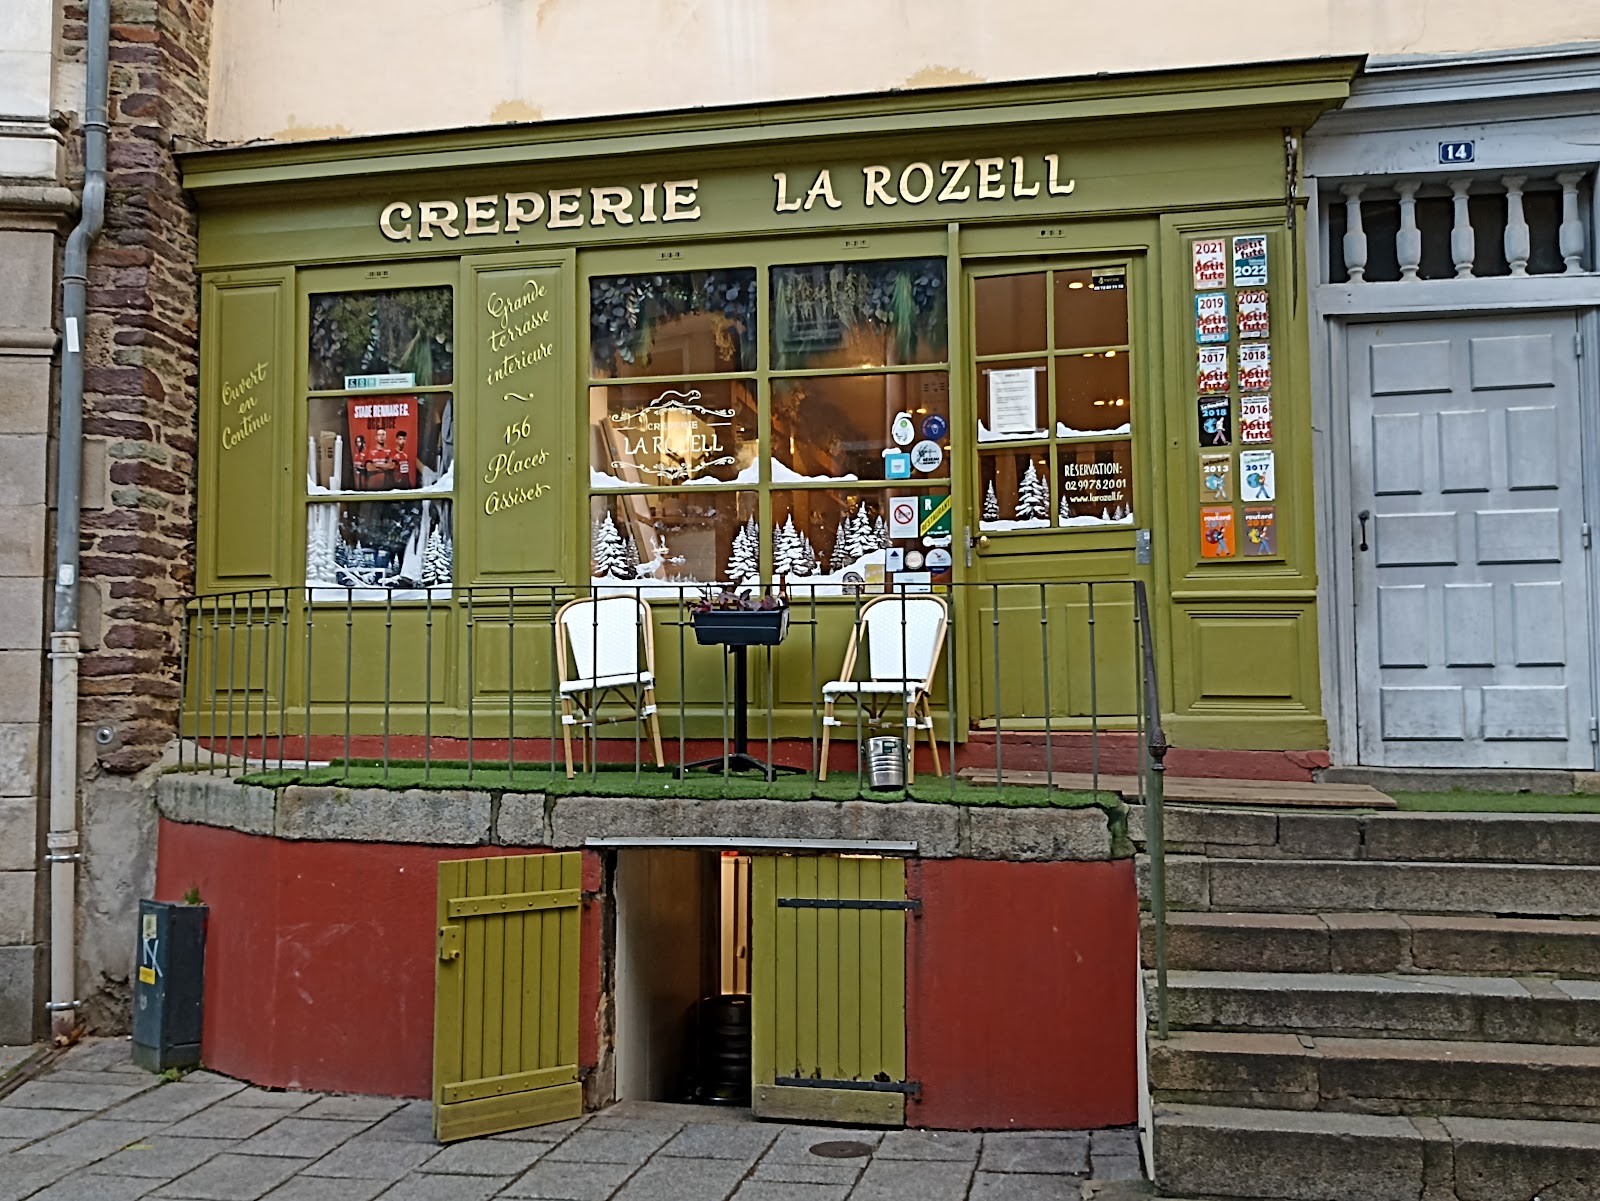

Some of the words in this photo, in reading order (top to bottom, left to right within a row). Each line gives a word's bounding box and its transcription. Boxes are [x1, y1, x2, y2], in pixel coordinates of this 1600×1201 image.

[1447, 144, 1467, 160] 14
[773, 169, 842, 214] LA
[862, 153, 1075, 207] ROZELL
[379, 179, 701, 242] CREPERIE
[1196, 243, 1222, 255] 2021
[1235, 240, 1263, 253] petit
[1195, 261, 1224, 274] petit
[1235, 266, 1265, 276] 2022
[487, 280, 548, 329] Grande
[1200, 298, 1224, 309] 2019
[1239, 294, 1266, 304] 2020
[1197, 314, 1227, 328] petit
[1238, 311, 1268, 324] petit
[487, 310, 550, 352] terrasse
[1201, 354, 1224, 363] 2017
[1242, 351, 1266, 360] 2018
[1239, 367, 1270, 380] petit
[222, 362, 269, 405] Ouvert
[238, 397, 258, 413] en
[1243, 405, 1268, 415] 2016
[1202, 408, 1227, 417] 2018
[222, 412, 271, 450] Continu
[503, 415, 531, 446] 156
[1241, 420, 1272, 433] petit
[624, 437, 648, 455] LA
[484, 448, 550, 484] Places
[1203, 465, 1229, 473] 2013
[1065, 480, 1077, 491] 02
[1078, 479, 1089, 491] 99
[1089, 479, 1101, 490] 78
[1102, 479, 1115, 490] 20
[1116, 478, 1126, 489] 01
[1069, 491, 1124, 503] www.larozell.fr
[925, 499, 932, 510] R
